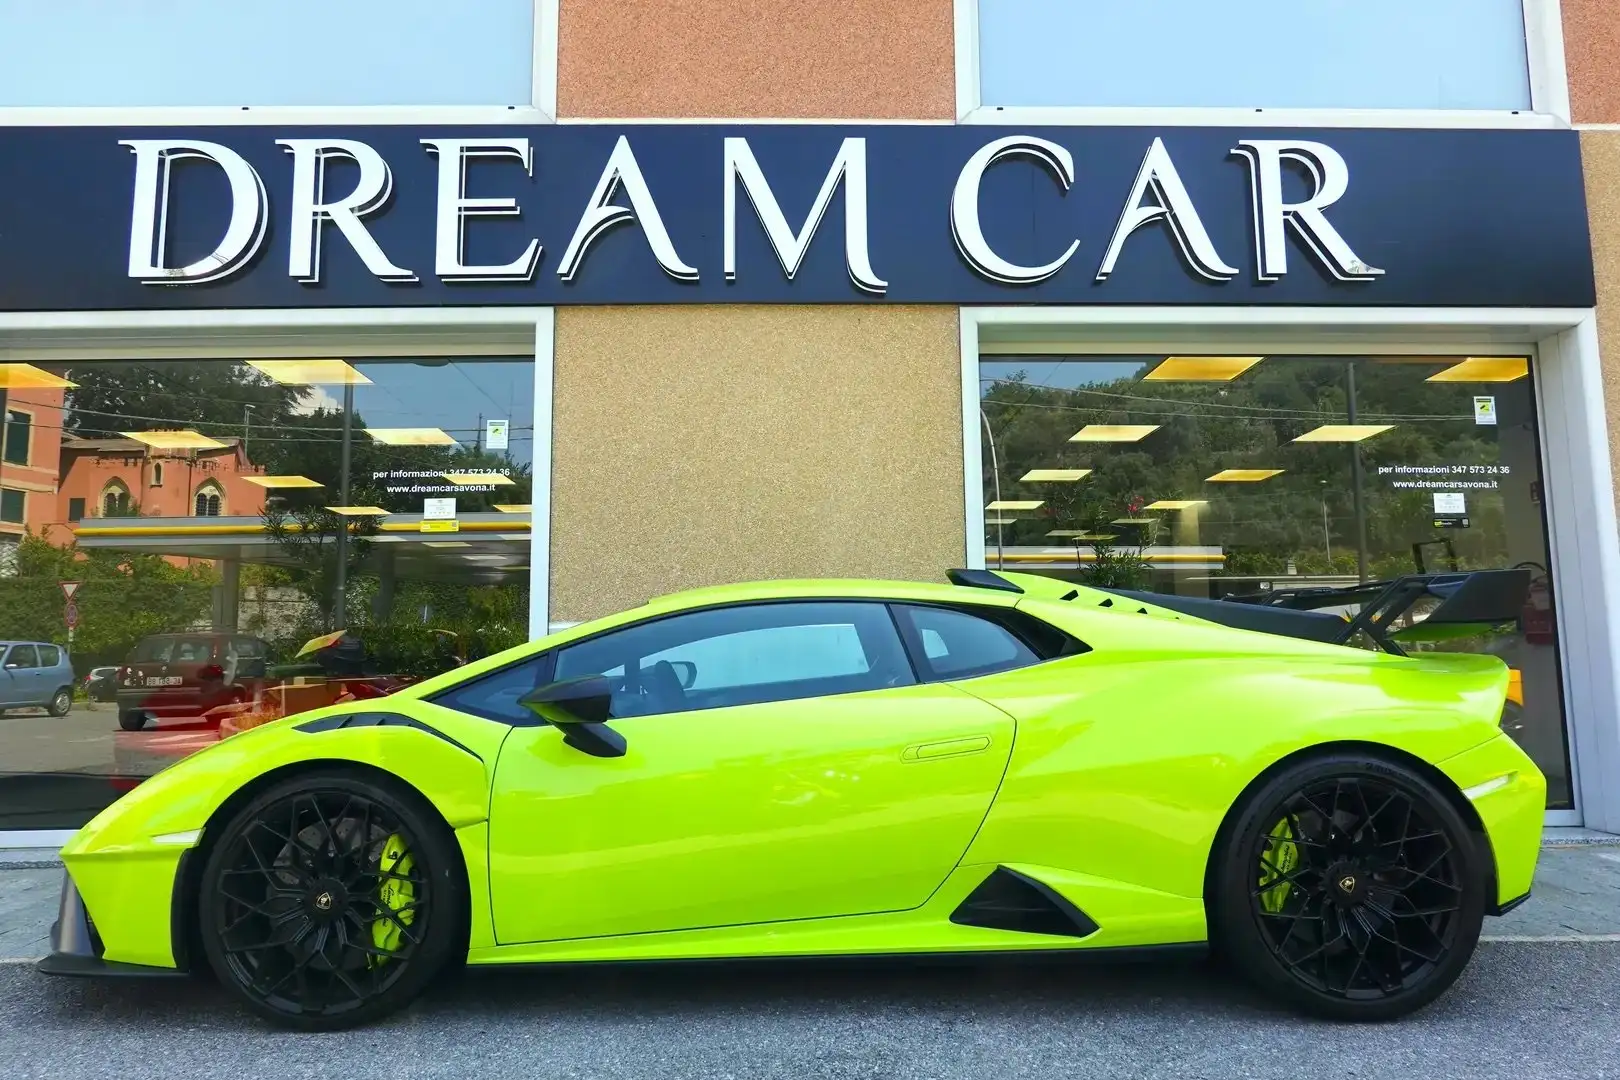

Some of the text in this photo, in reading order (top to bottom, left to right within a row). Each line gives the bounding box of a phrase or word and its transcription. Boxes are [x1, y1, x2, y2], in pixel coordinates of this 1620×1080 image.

[118, 134, 1385, 293] DREAM CAR
[373, 470, 387, 480] per
[390, 469, 447, 479] informazioni
[449, 468, 466, 476] 347
[486, 468, 497, 476] 24
[499, 468, 510, 477] 36
[1378, 465, 1510, 475] per informazioni 347 573 24 36
[386, 483, 496, 493] www.dreamcarsavona.it
[1392, 480, 1498, 489] www.dreamcarsavona.it
